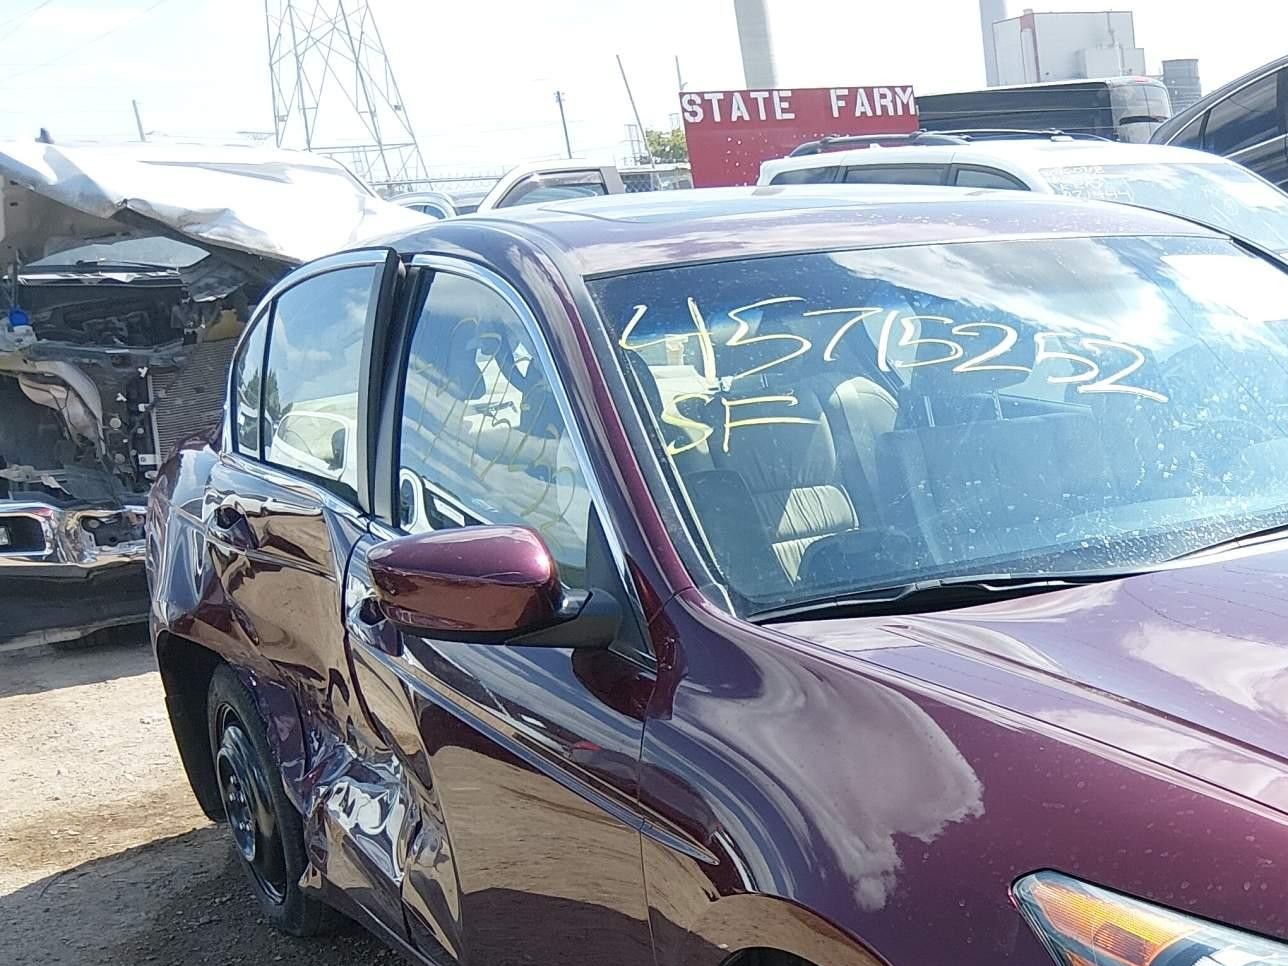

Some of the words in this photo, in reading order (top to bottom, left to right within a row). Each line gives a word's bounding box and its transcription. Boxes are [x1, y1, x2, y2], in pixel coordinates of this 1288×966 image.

[682, 90, 795, 123] STATE
[830, 86, 918, 118] FARM
[618, 296, 1168, 402] 45715252
[661, 394, 821, 455] SF
